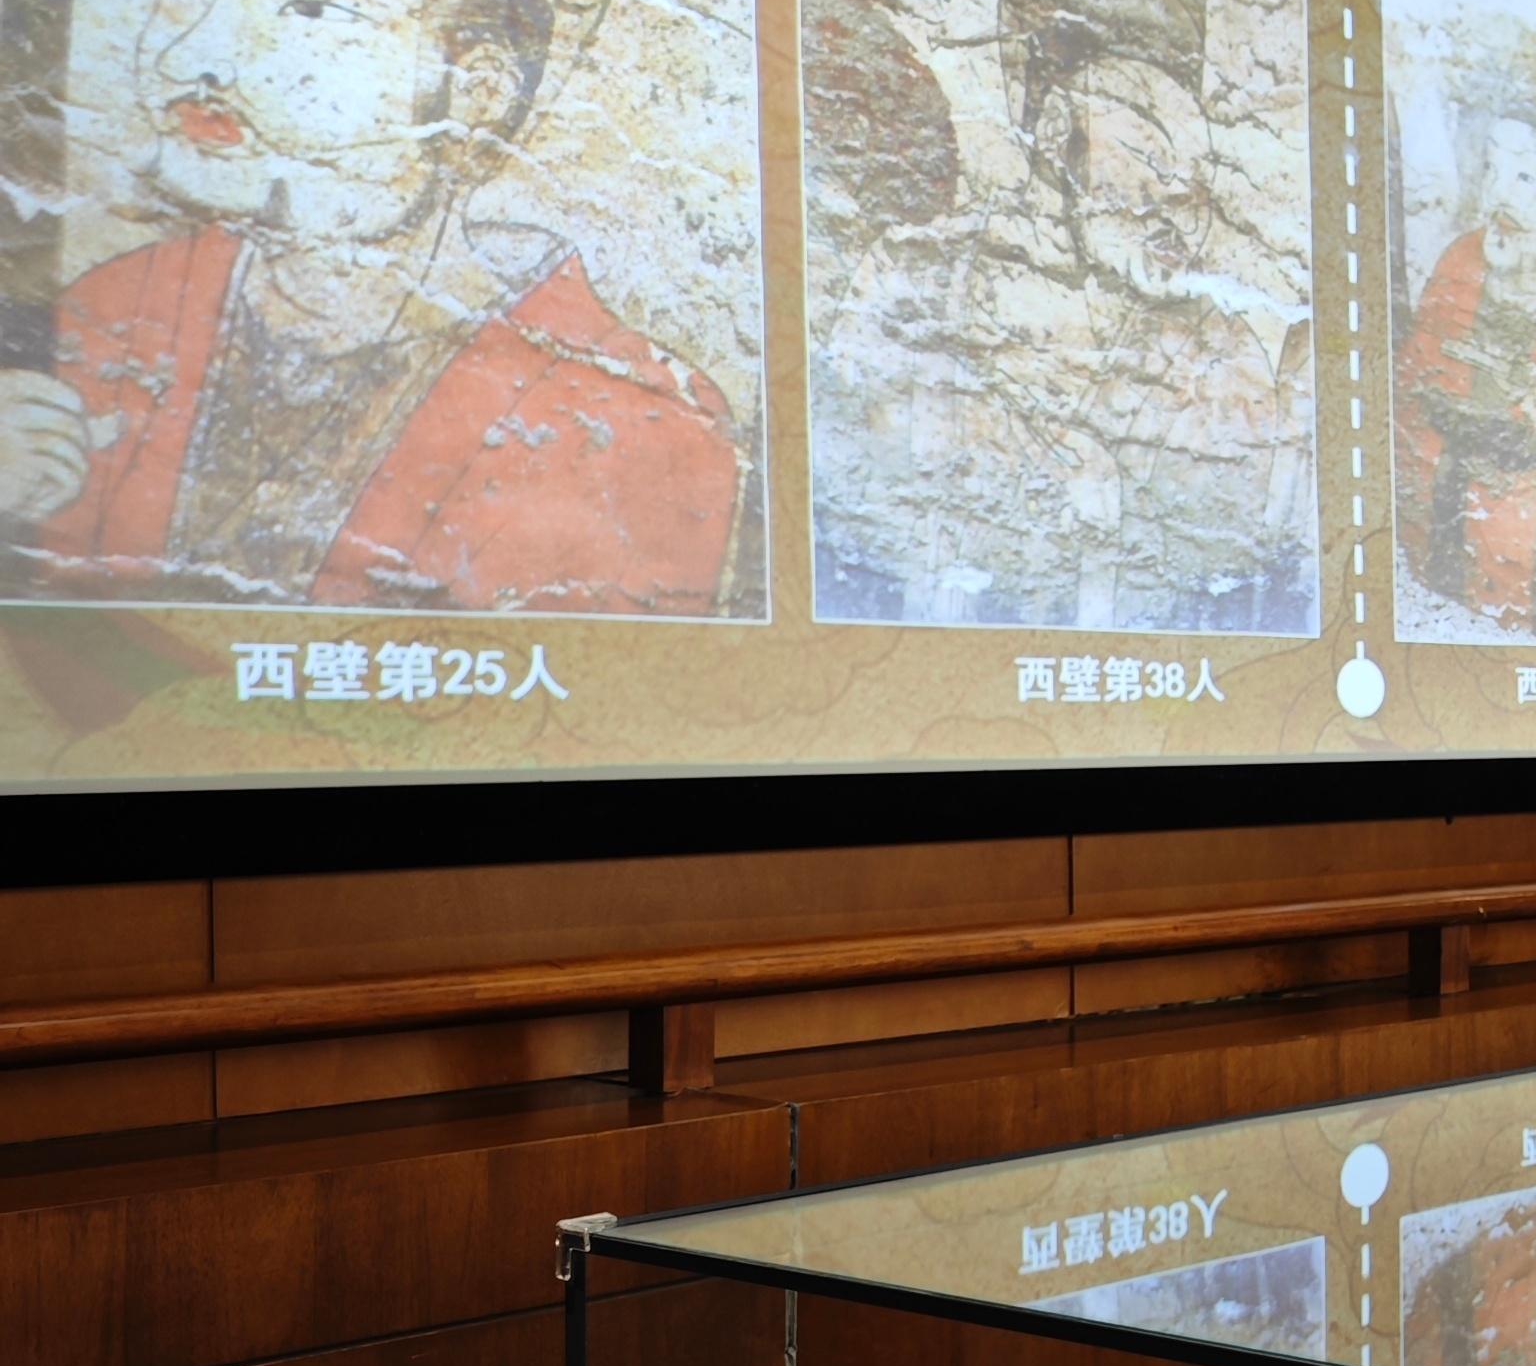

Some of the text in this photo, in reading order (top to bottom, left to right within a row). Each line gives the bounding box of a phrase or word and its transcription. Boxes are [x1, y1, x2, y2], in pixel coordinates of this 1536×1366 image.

[232, 639, 570, 703] 西壁第25人
[1014, 654, 1226, 703] 西壁第38人
